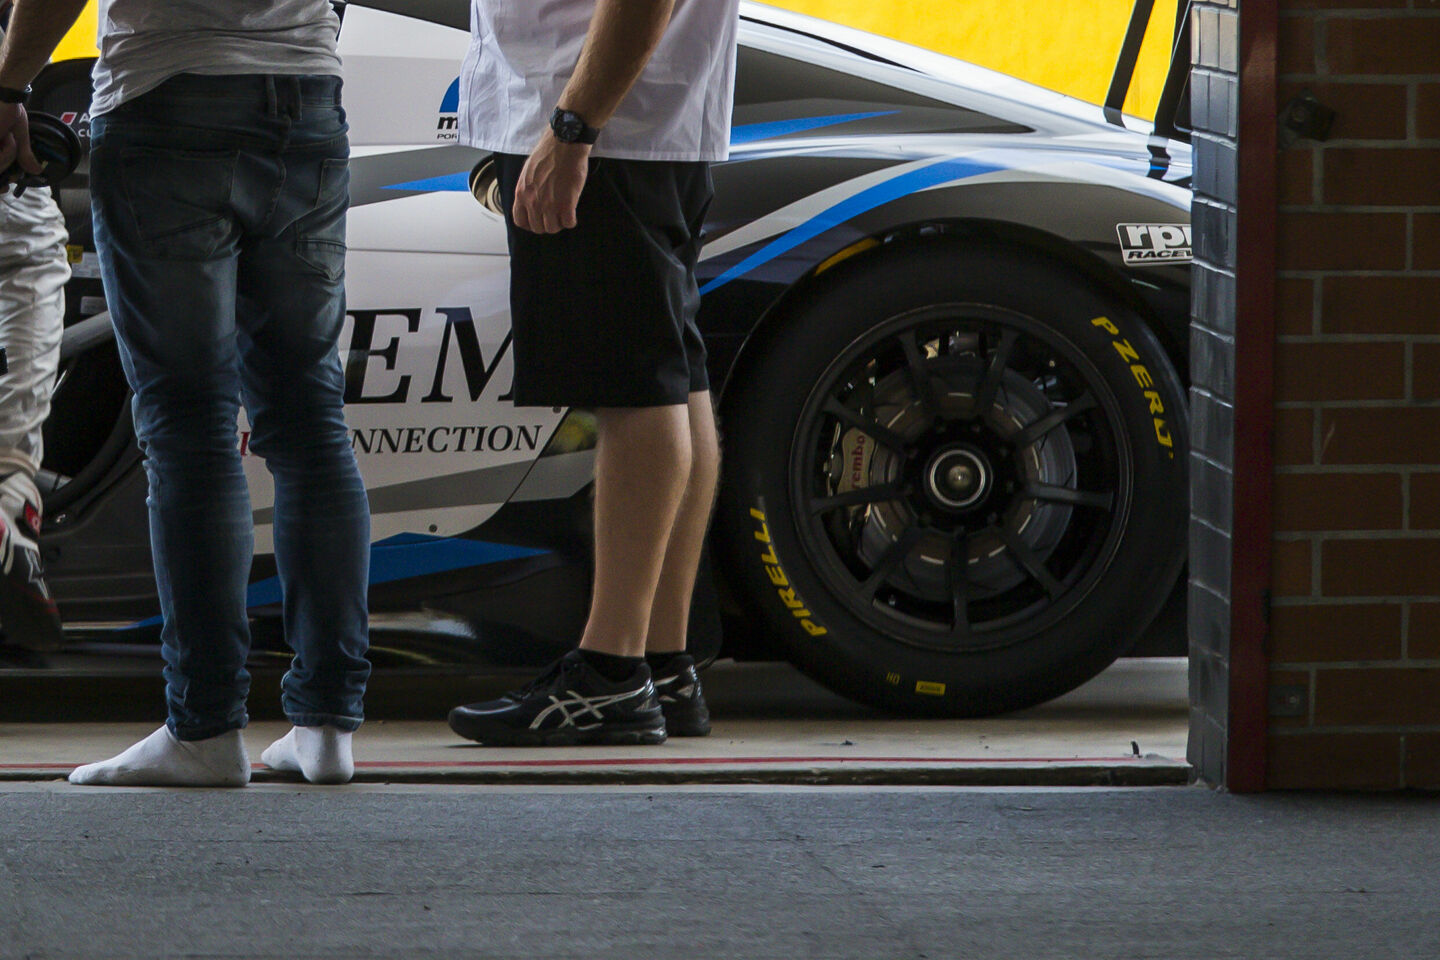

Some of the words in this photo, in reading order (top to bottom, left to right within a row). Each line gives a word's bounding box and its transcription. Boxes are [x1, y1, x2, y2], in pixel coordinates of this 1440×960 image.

[1126, 225, 1192, 251] rp
[1128, 250, 1192, 259] RACE
[343, 306, 514, 404] EM
[351, 424, 542, 454] NNECTION
[851, 434, 866, 490] rembo
[749, 507, 828, 636] PIRELLI
